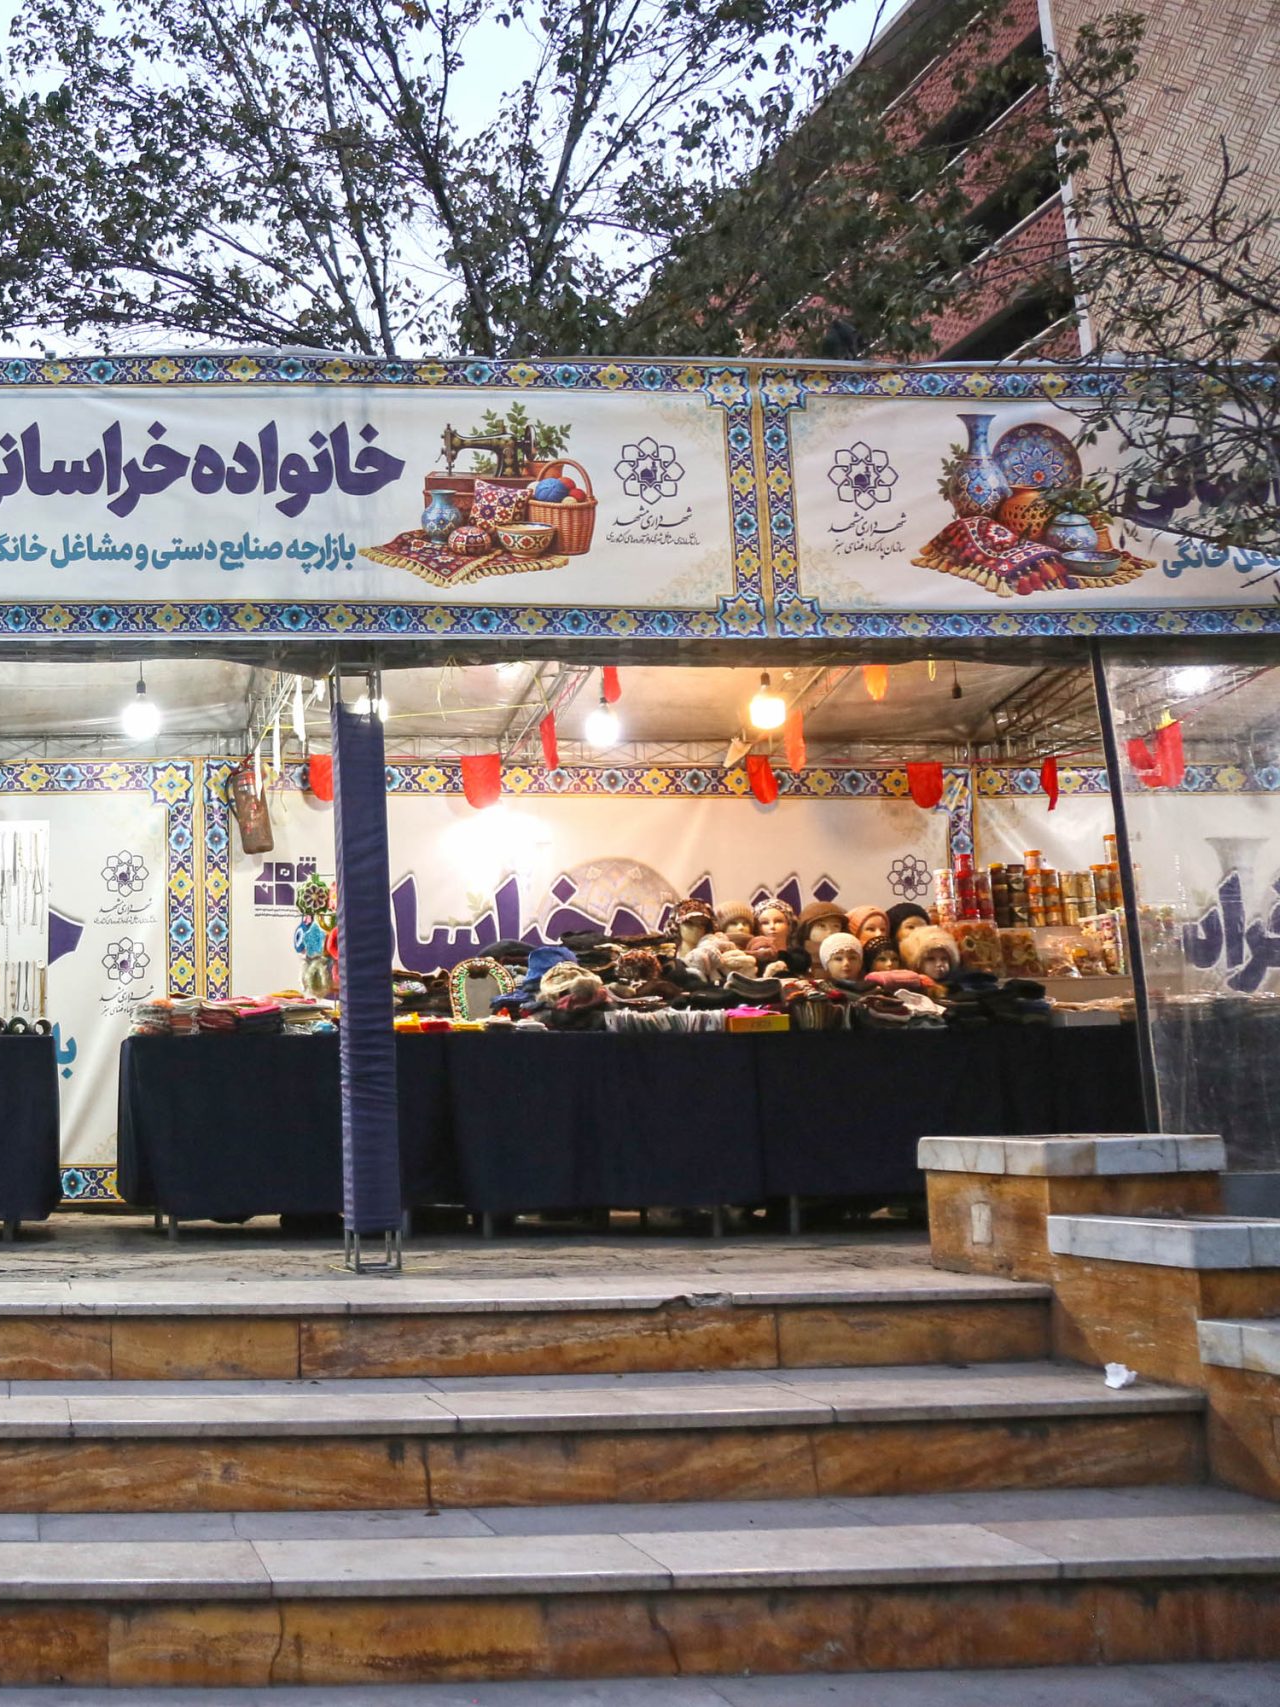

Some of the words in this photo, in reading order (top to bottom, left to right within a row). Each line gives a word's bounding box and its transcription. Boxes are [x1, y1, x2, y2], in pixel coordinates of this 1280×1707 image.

[189, 420, 406, 518] خانواده
[50, 532, 134, 569] مشاغل
[134, 542, 149, 571] و
[151, 537, 218, 570] دستی
[219, 532, 284, 571] صنایع
[285, 532, 356, 574] بازارچه
